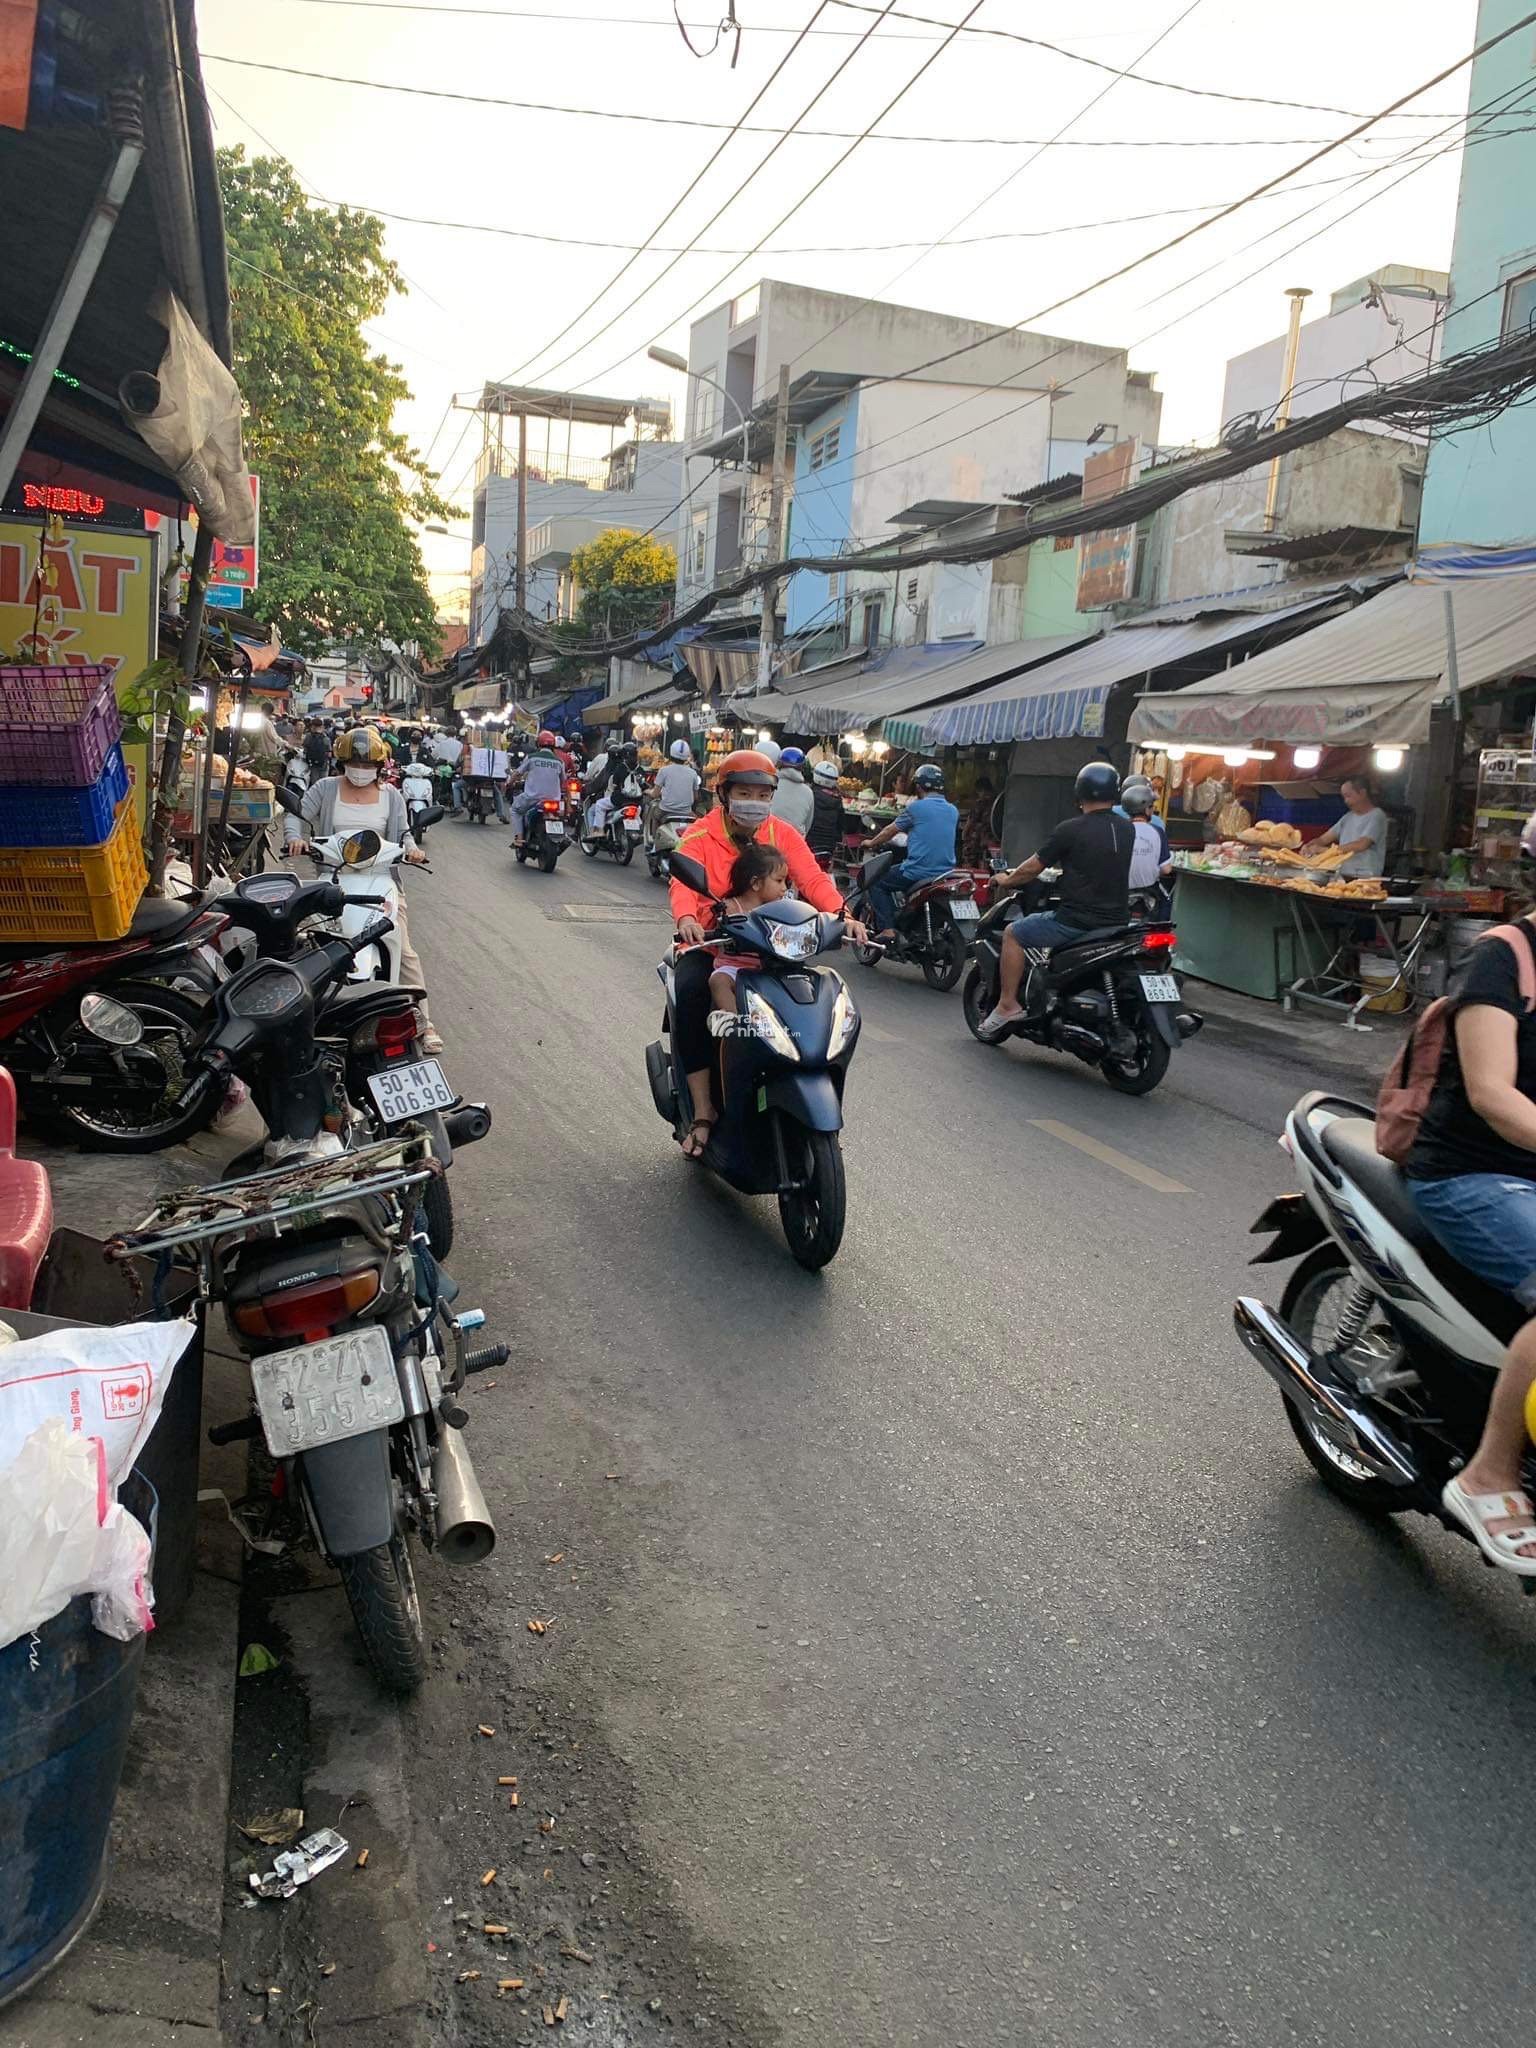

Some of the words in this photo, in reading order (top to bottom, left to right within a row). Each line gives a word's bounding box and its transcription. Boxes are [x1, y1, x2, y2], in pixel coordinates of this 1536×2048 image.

[379, 1065, 431, 1095] 50-N1
[382, 1084, 448, 1118] 606.96
[279, 1271, 318, 1287] HONDA
